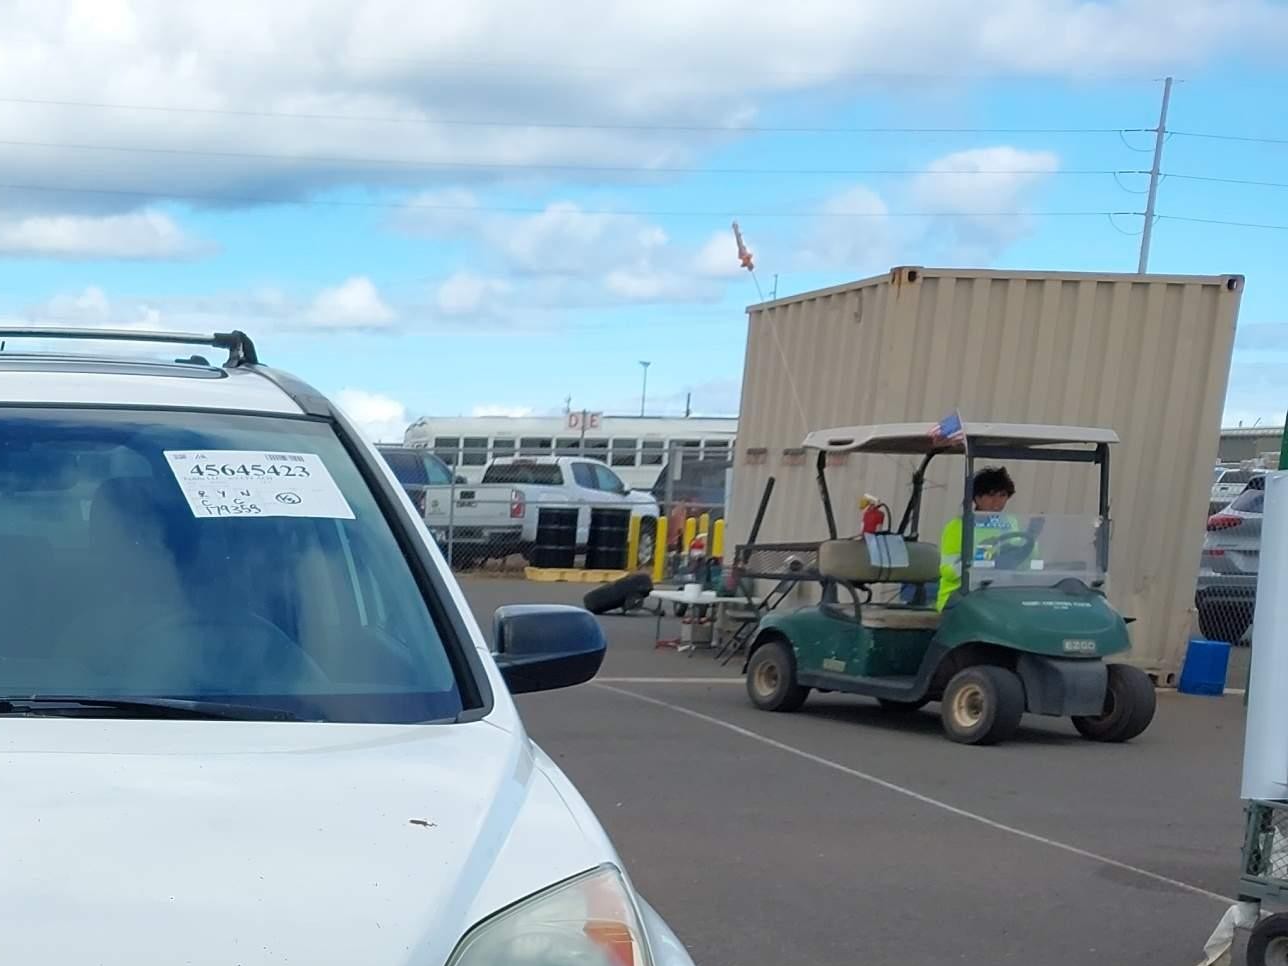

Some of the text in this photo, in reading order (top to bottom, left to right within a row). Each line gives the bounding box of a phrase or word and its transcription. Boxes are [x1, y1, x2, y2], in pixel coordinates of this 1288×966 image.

[568, 413, 600, 428] D E
[190, 464, 310, 477] 45645423
